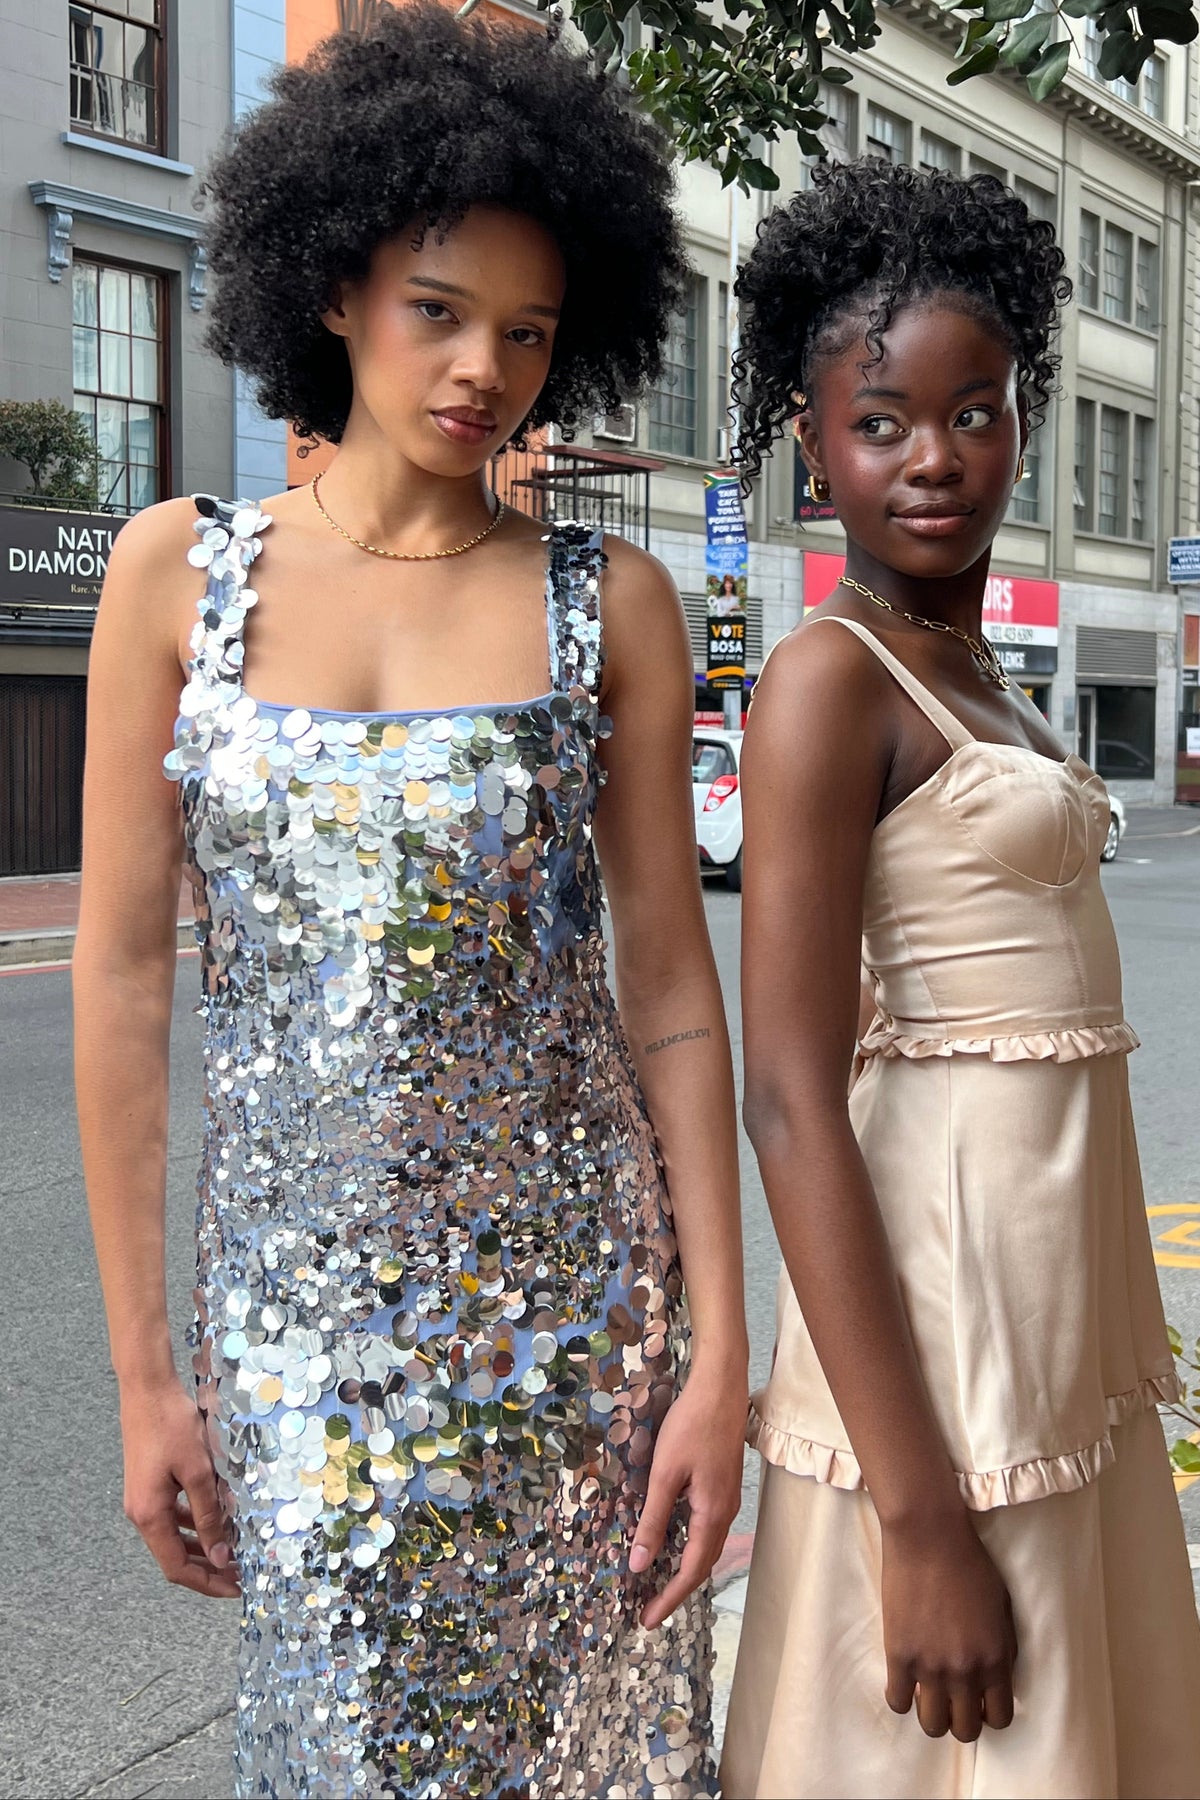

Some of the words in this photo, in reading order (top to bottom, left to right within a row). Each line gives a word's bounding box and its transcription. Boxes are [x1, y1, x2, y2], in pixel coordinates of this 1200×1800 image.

[713, 526, 729, 534] FOR
[711, 625, 743, 638] VOTE
[710, 640, 743, 653] BOSA
